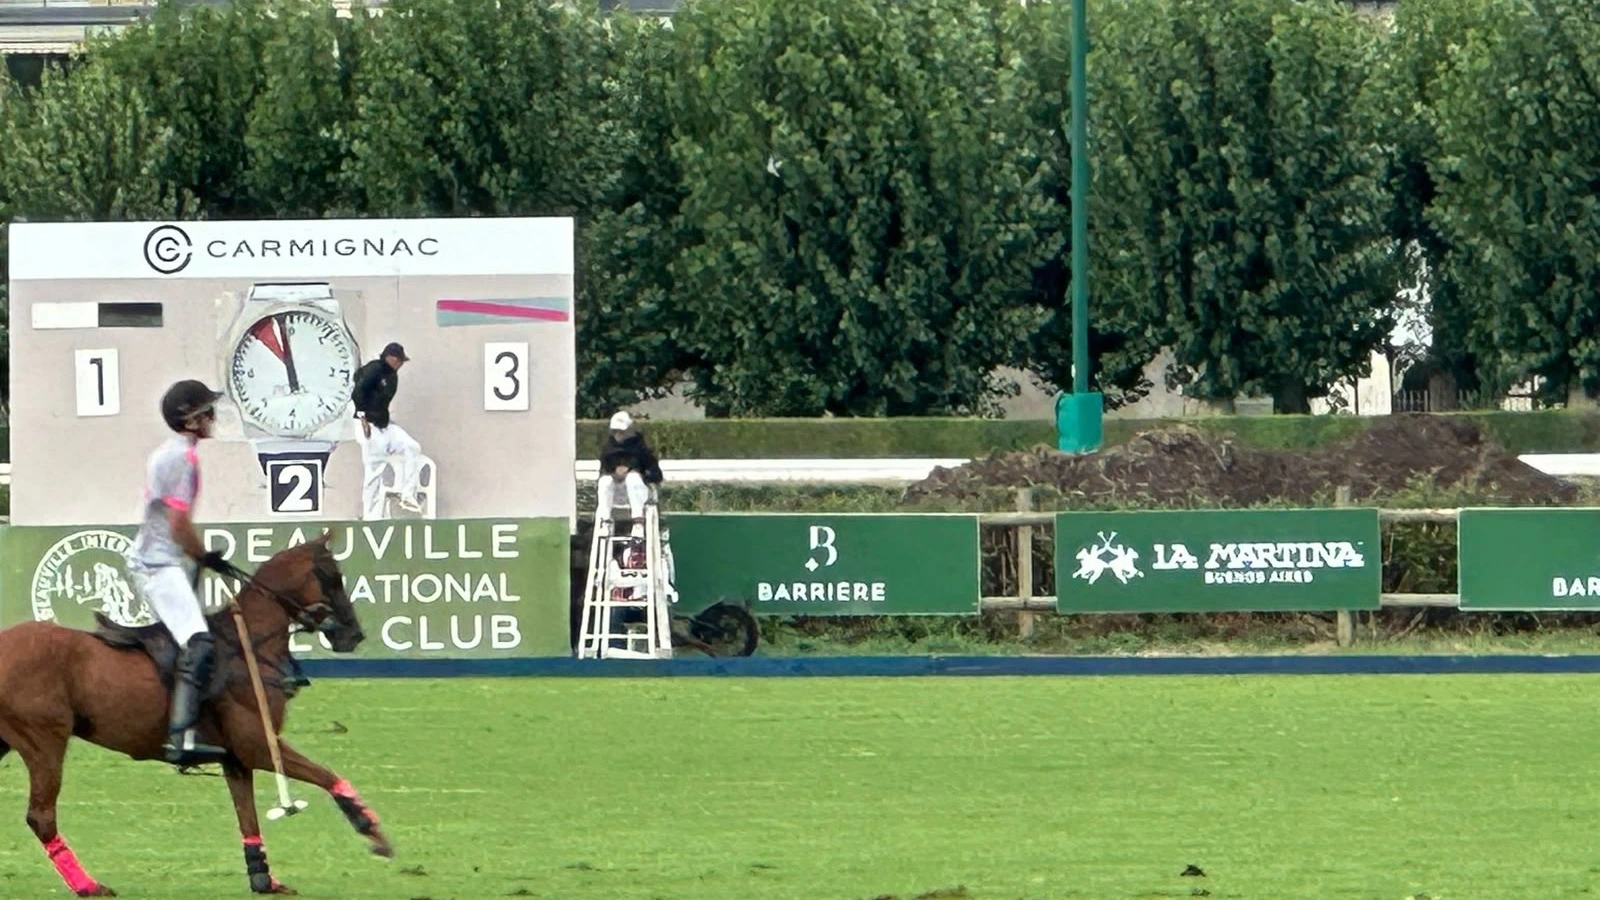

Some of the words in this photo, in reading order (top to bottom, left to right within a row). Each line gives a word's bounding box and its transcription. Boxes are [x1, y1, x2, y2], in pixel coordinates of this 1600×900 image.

[207, 238, 439, 257] CARMIGNAC
[89, 357, 104, 406] 1
[493, 351, 520, 401] 3
[278, 465, 313, 511] 2
[1152, 543, 1199, 569] LA
[1204, 541, 1365, 568] MARTINA
[204, 572, 520, 606] INATIONAL
[381, 614, 522, 650] CLUB
